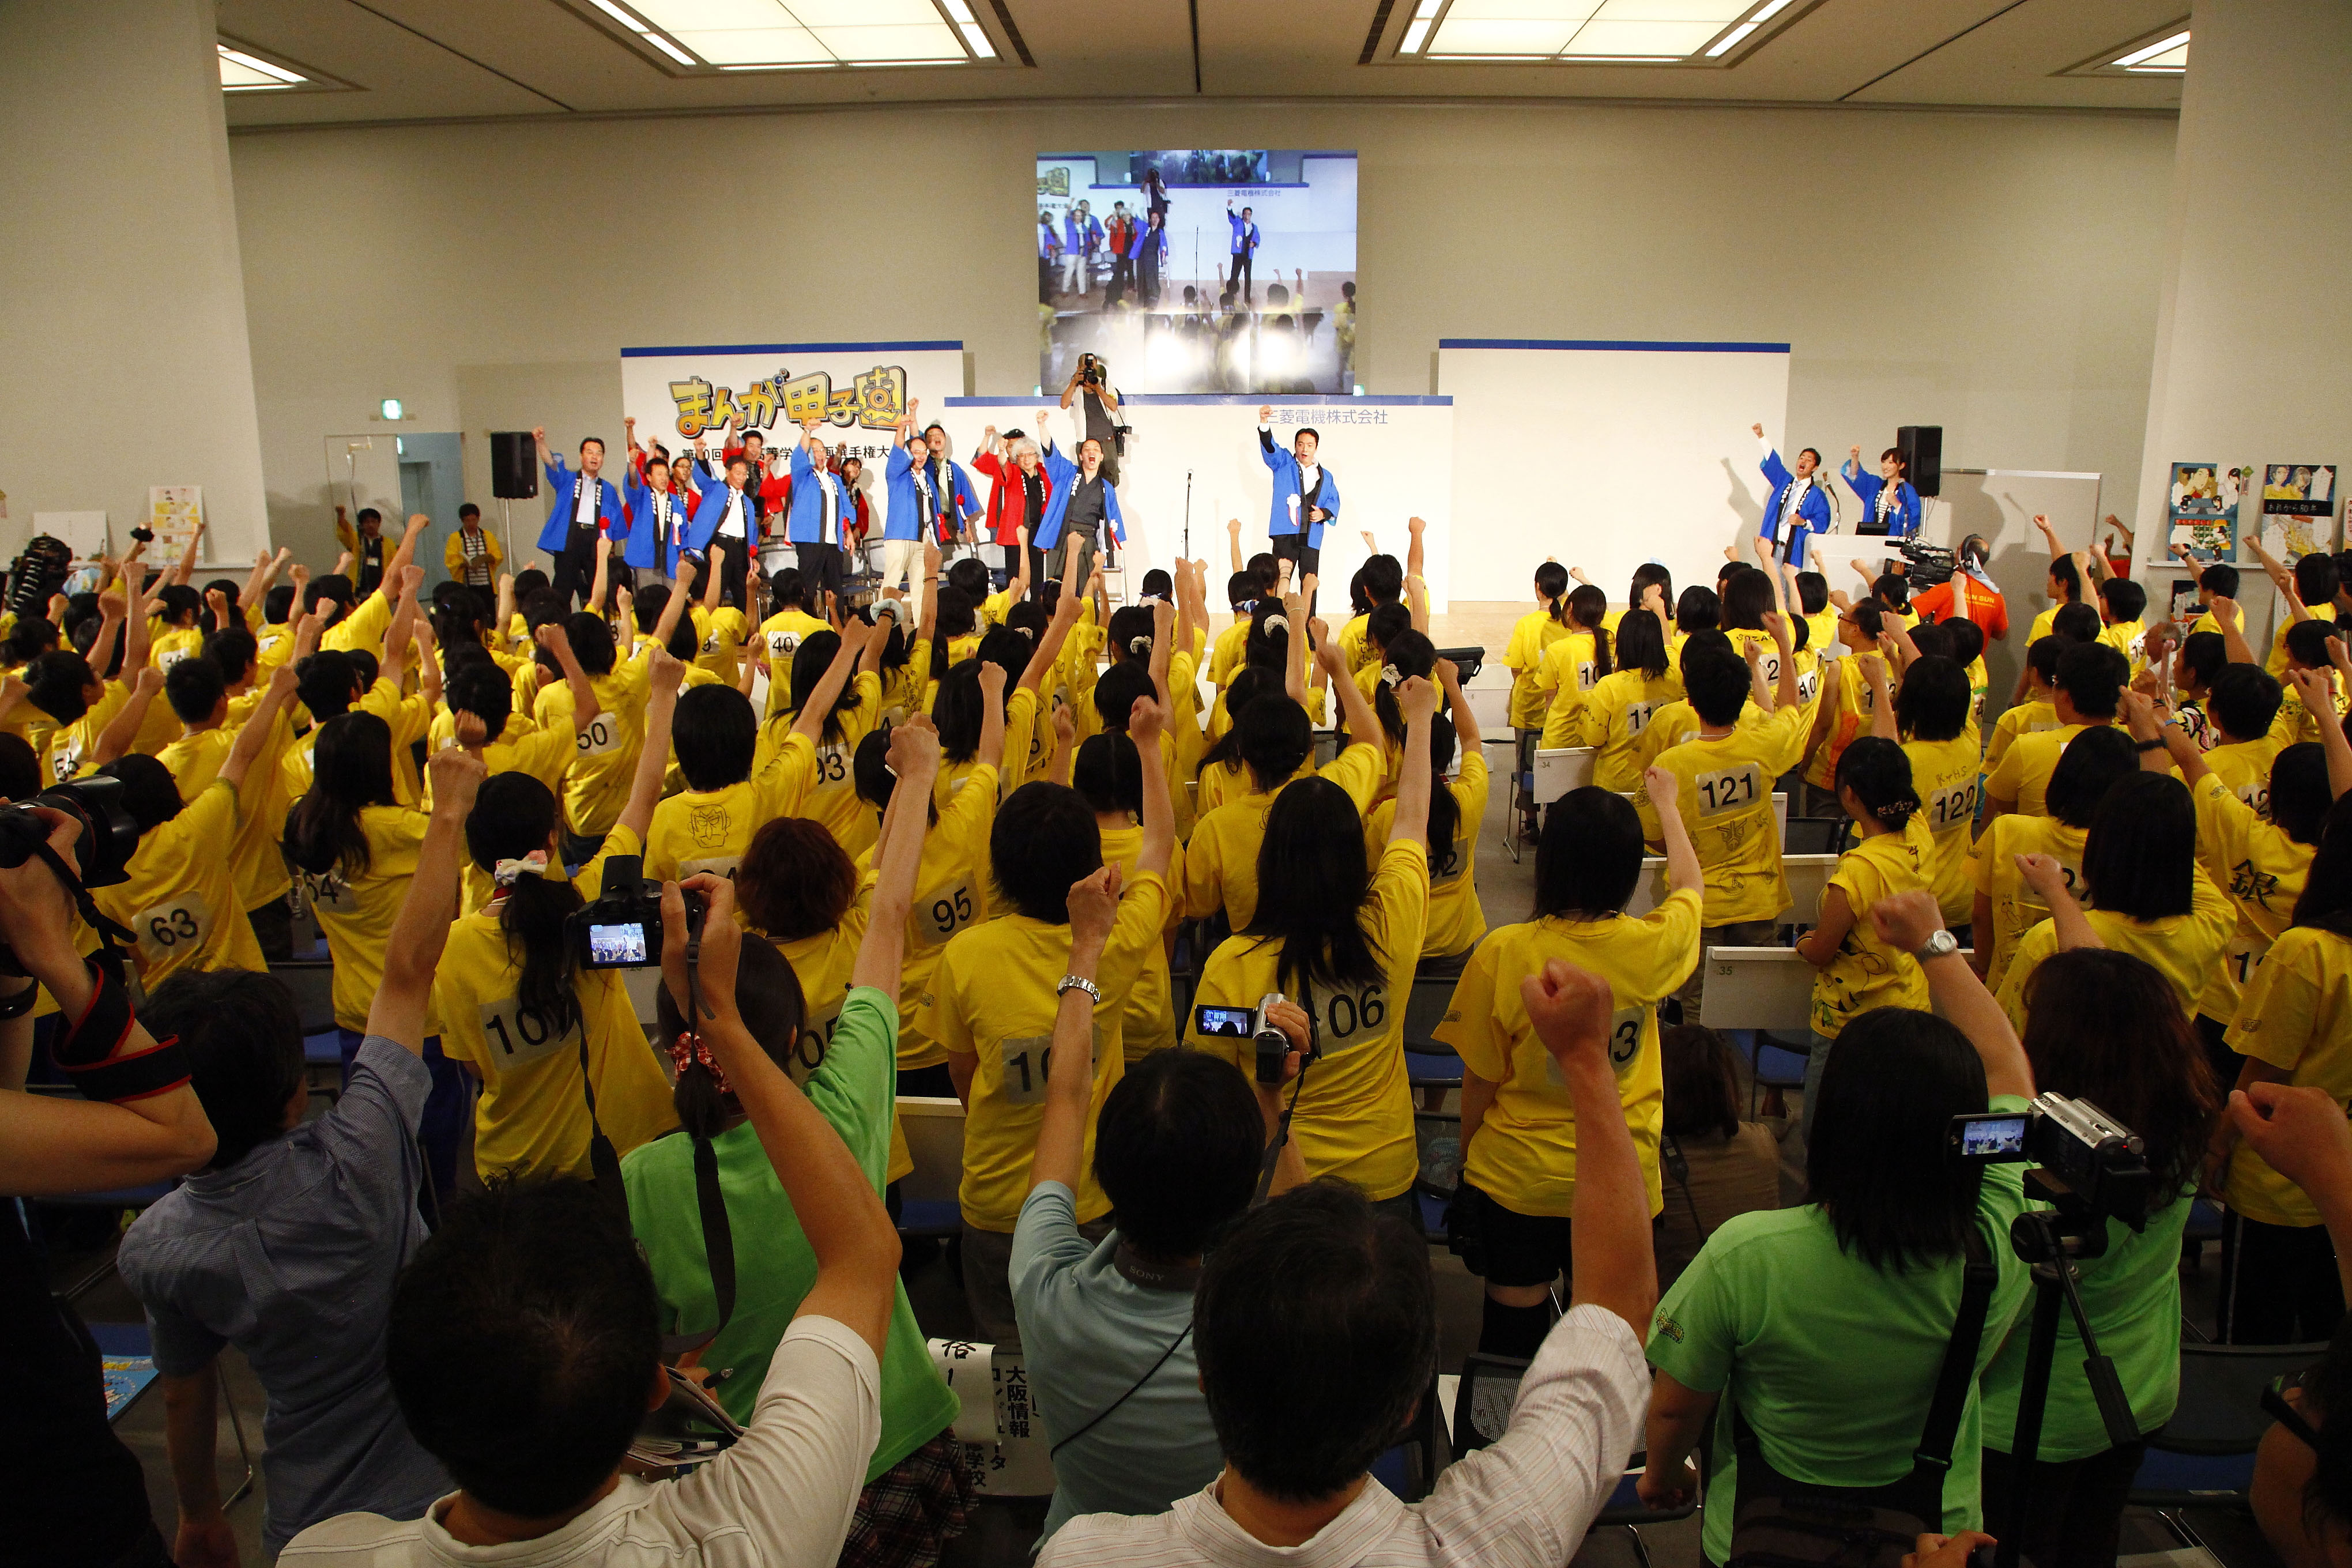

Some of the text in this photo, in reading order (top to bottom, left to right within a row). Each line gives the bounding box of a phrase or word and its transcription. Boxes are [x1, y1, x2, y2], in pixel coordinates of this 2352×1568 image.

[668, 365, 907, 439] まんが甲子園
[1268, 409, 1388, 424] 三菱電機株式会社
[1978, 595, 1995, 604] SUN
[772, 636, 793, 653] 40
[1702, 772, 1752, 808] 121
[1936, 785, 1975, 823] 122
[2229, 858, 2279, 913] 銀
[150, 908, 199, 947] 63
[932, 886, 972, 933] 95
[1720, 966, 1732, 975] 35
[1328, 985, 1385, 1038] 06
[1005, 1366, 1030, 1438] 大阪情報
